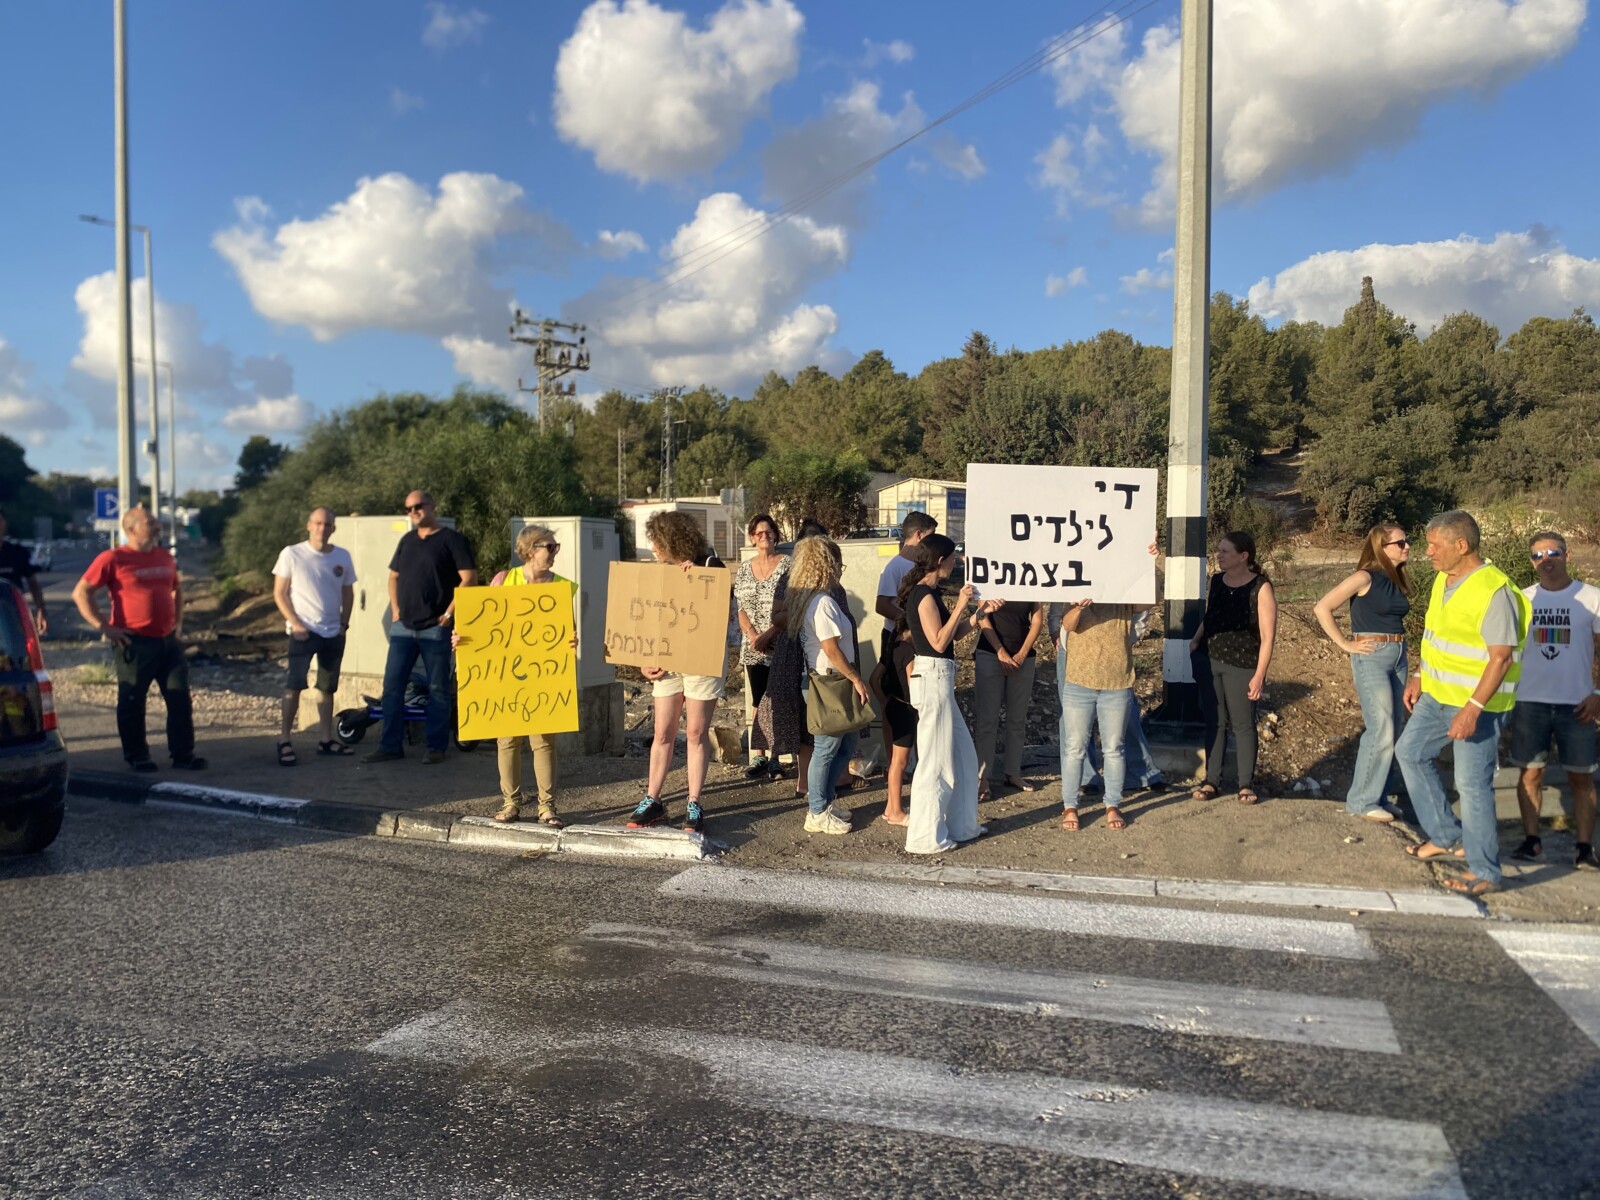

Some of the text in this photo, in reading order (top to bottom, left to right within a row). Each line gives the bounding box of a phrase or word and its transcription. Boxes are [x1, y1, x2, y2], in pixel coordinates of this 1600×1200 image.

[1094, 480, 1141, 510] די
[1010, 510, 1114, 551] לילדים
[686, 574, 716, 600] די
[463, 594, 557, 626] סכנת
[629, 597, 700, 634] לילדים
[1532, 615, 1571, 626] PANDA
[474, 620, 566, 652] נפשות
[457, 652, 568, 692] והרשויות
[459, 687, 572, 729] מתעלמות
